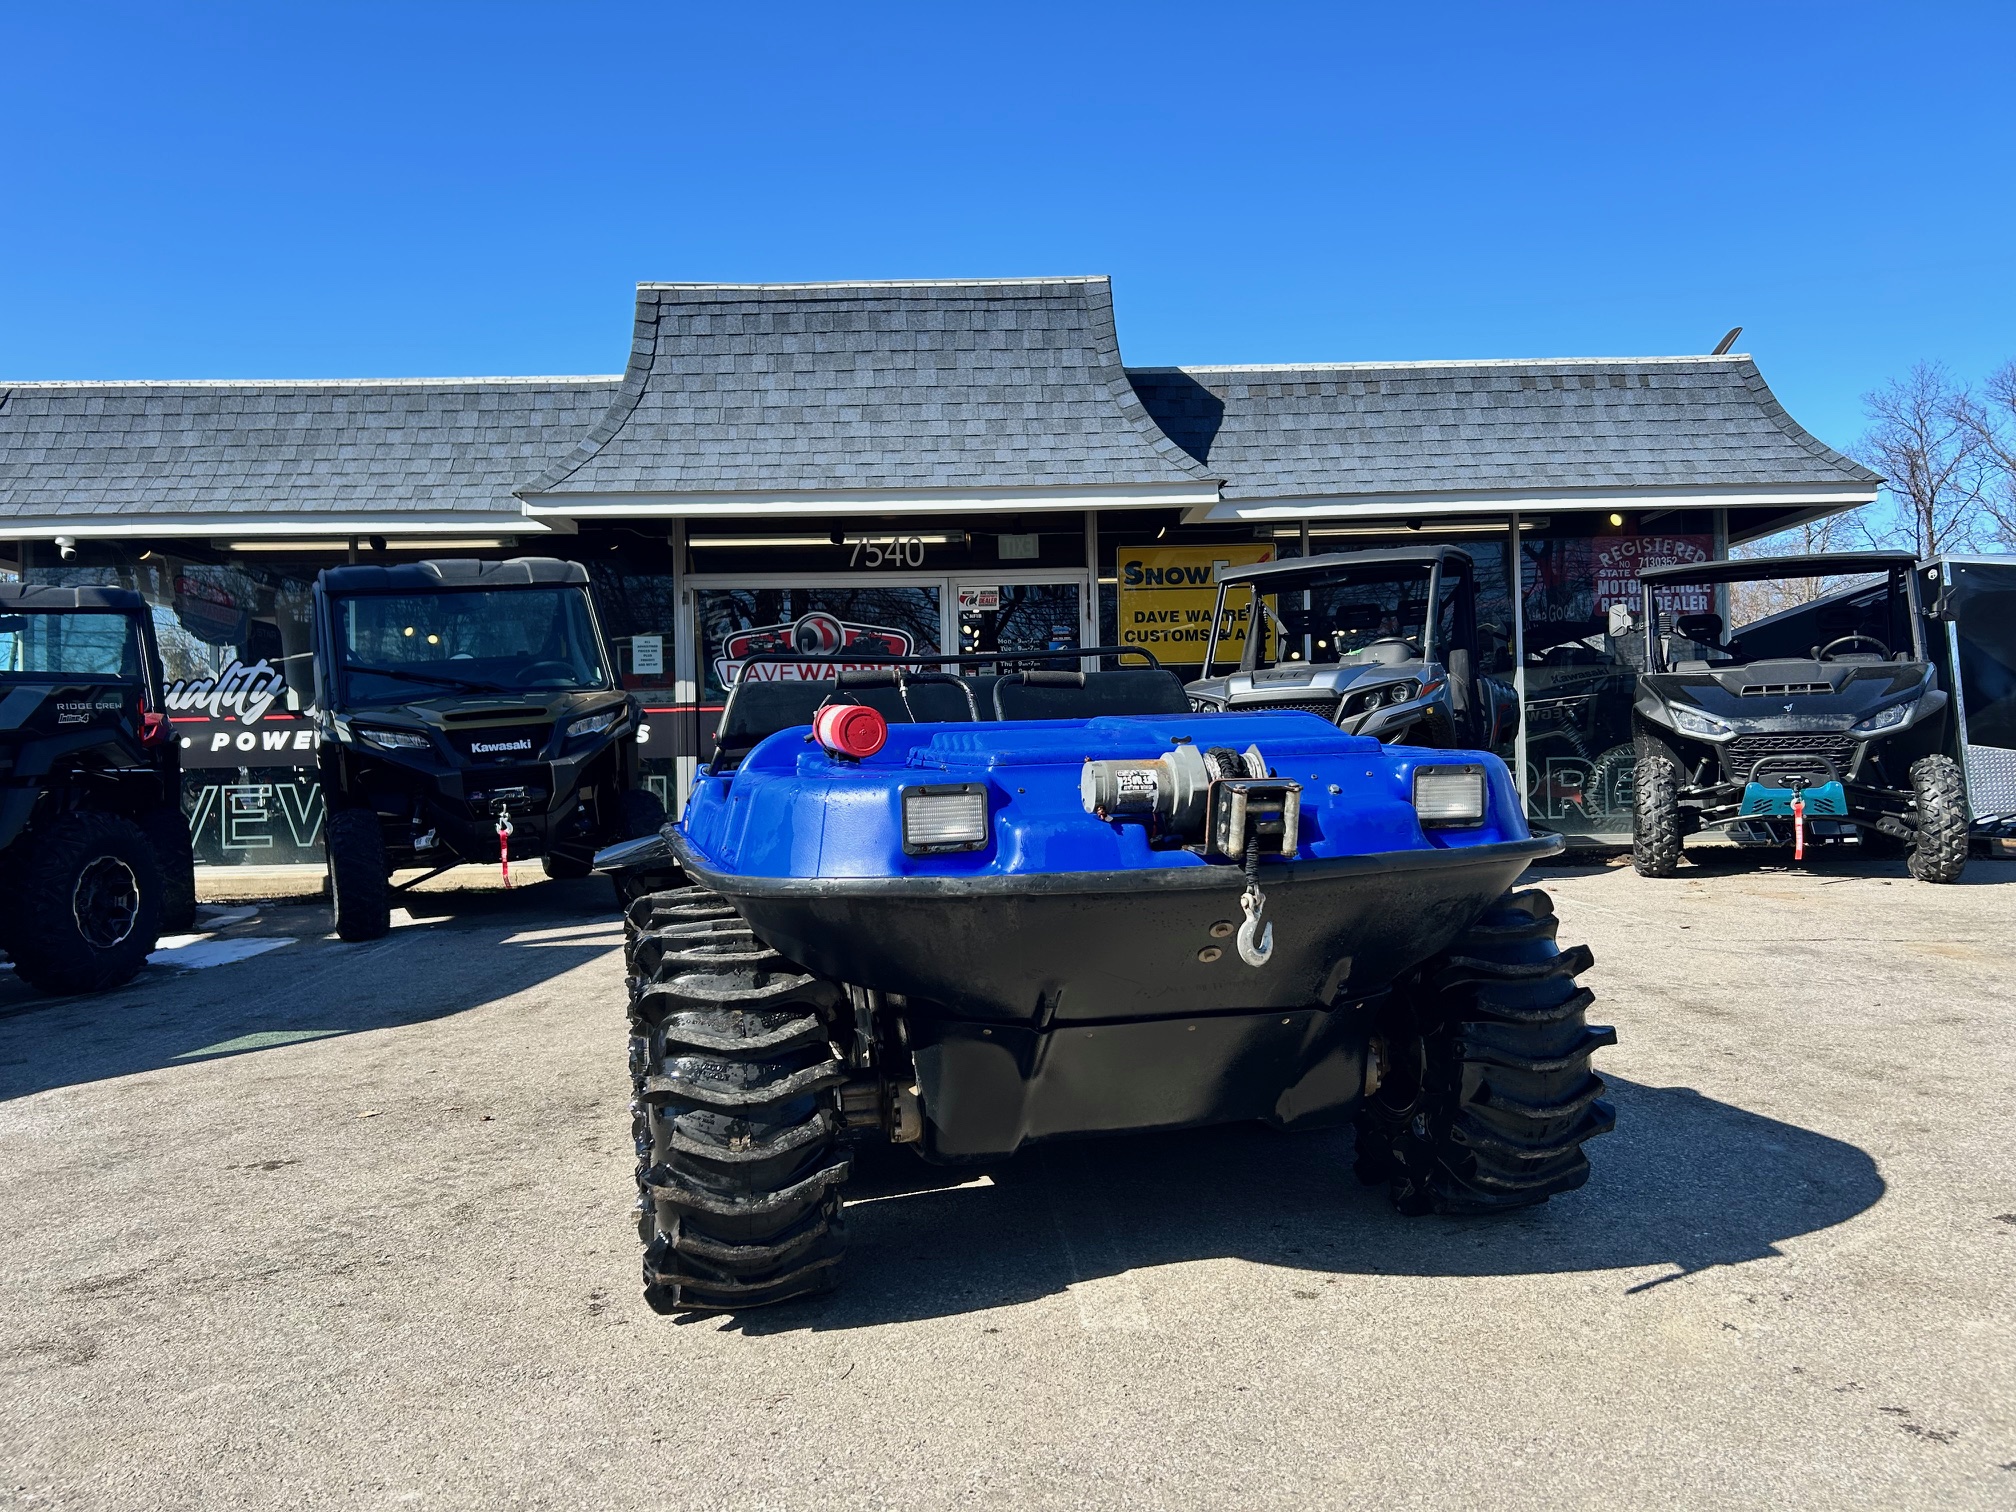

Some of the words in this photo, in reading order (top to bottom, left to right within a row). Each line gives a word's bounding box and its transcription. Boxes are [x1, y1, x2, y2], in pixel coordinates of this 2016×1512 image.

[850, 536, 925, 567] 7540
[1599, 538, 1706, 568] REGISTERED
[1638, 557, 1677, 568] 7130352
[1599, 569, 1630, 577] STATE
[1601, 596, 1641, 612] RETAI
[1655, 595, 1708, 611] DEALER
[1134, 610, 1180, 623] DAVE
[1124, 629, 1210, 643] CUSTOMS
[163, 659, 289, 725] uality
[56, 702, 93, 710] RIDGE
[95, 702, 122, 710] CREW
[471, 739, 531, 753] Kawasaki
